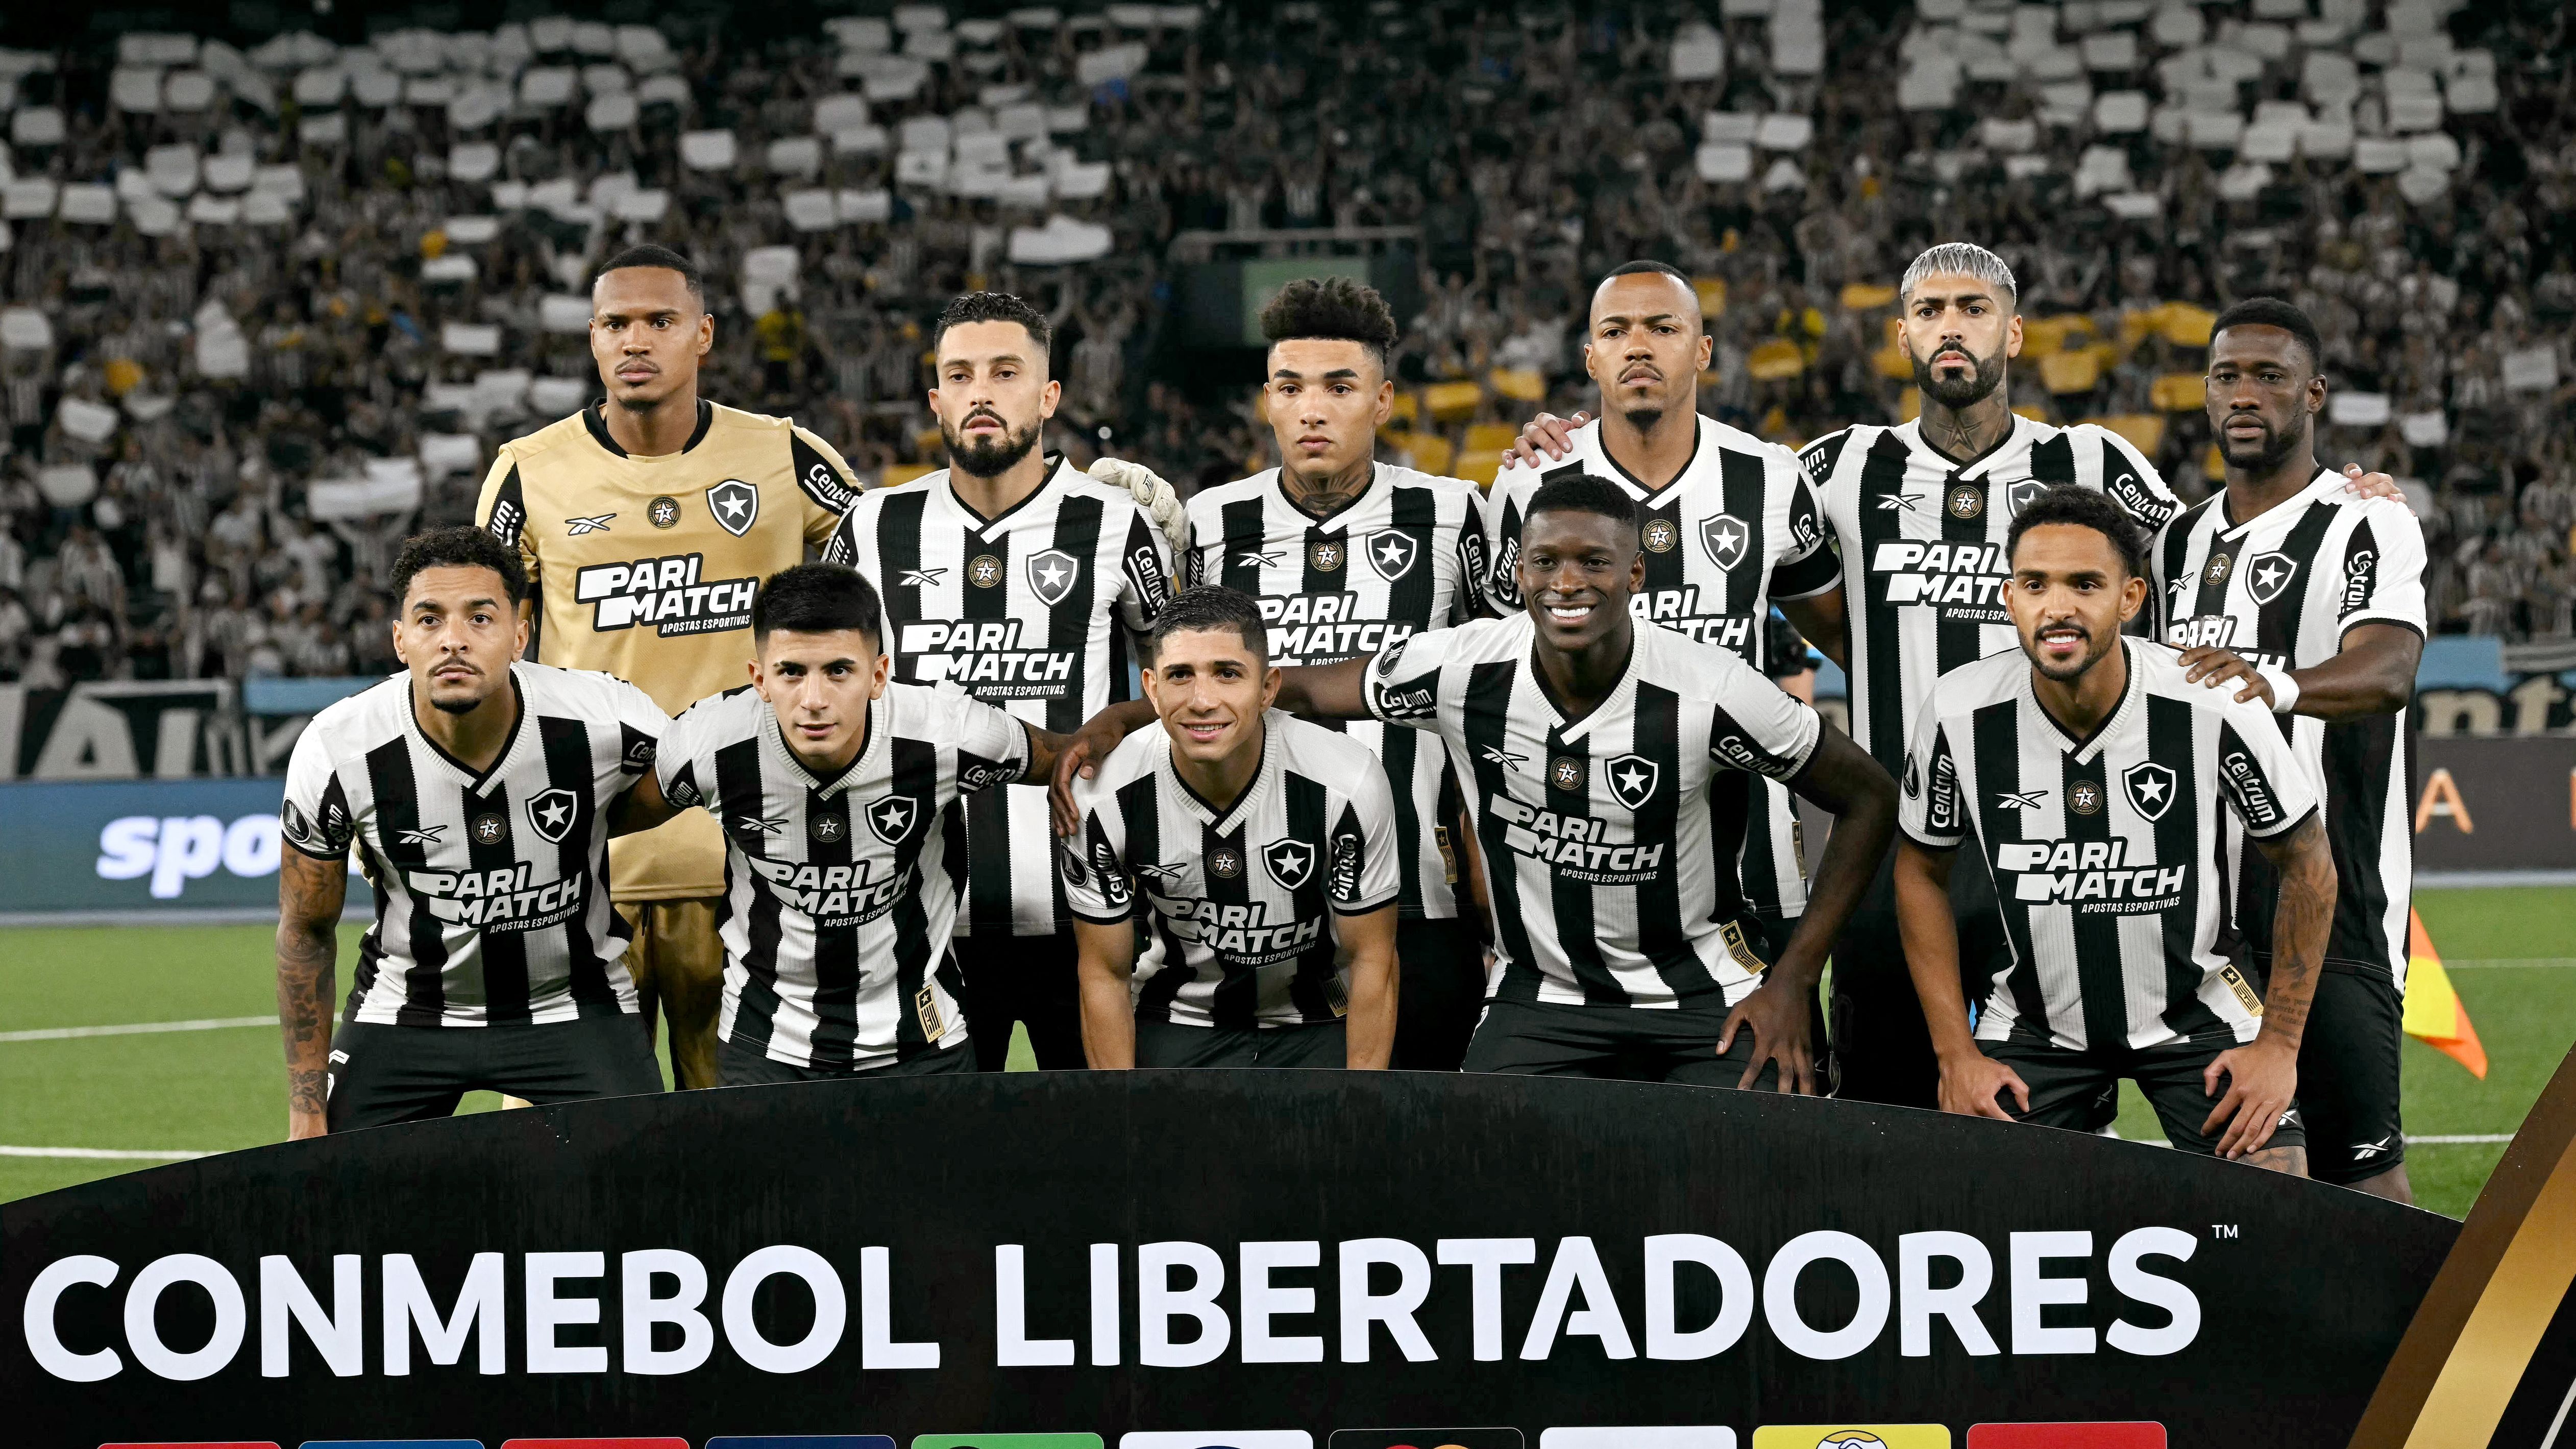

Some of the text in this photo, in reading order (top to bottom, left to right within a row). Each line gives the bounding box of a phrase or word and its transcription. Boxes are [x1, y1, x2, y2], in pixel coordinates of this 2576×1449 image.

[1873, 544, 1995, 574] PARI
[579, 557, 698, 600] PARI
[1886, 574, 2014, 606] MAT
[598, 582, 756, 628] MATCH
[1256, 595, 1354, 625] PARI
[1629, 589, 1695, 620] ARI
[1946, 608, 1986, 619] APOSTAS
[661, 615, 750, 634] APOSTAS ESPORTIVAS
[901, 623, 1018, 653] PARI
[1266, 624, 1412, 656] MATCH
[1661, 618, 1750, 646] TCH
[915, 652, 1074, 681] MATCH
[975, 685, 1065, 696] APOSTAS ESPORTIVAS
[1931, 754, 1954, 827] Centrum
[2225, 752, 2276, 822] Centrum
[1490, 793, 1604, 846] PARI
[1505, 823, 1663, 870] MATCH
[1998, 841, 2122, 871] PARI
[409, 865, 528, 898] PARI
[747, 858, 866, 890] PARI
[768, 863, 913, 916] MATCH
[1560, 868, 1658, 882] APOSTAS ESPORTIVAS
[2016, 864, 2186, 901] MATCH
[429, 869, 582, 925] MATCH
[824, 888, 907, 927] APOSTAS ESPORTIVAS
[2081, 896, 2180, 914] APOSTAS ESPORTIVAS
[490, 902, 580, 934] APOSTAS ESPORTIVAS
[1155, 898, 1263, 929] PARI
[1168, 915, 1321, 952] MATCH
[1224, 941, 1316, 965] APOSTAS ESPORTIVAS
[24, 1224, 2238, 1382] CONMEBOL LIBERTADORES TM
